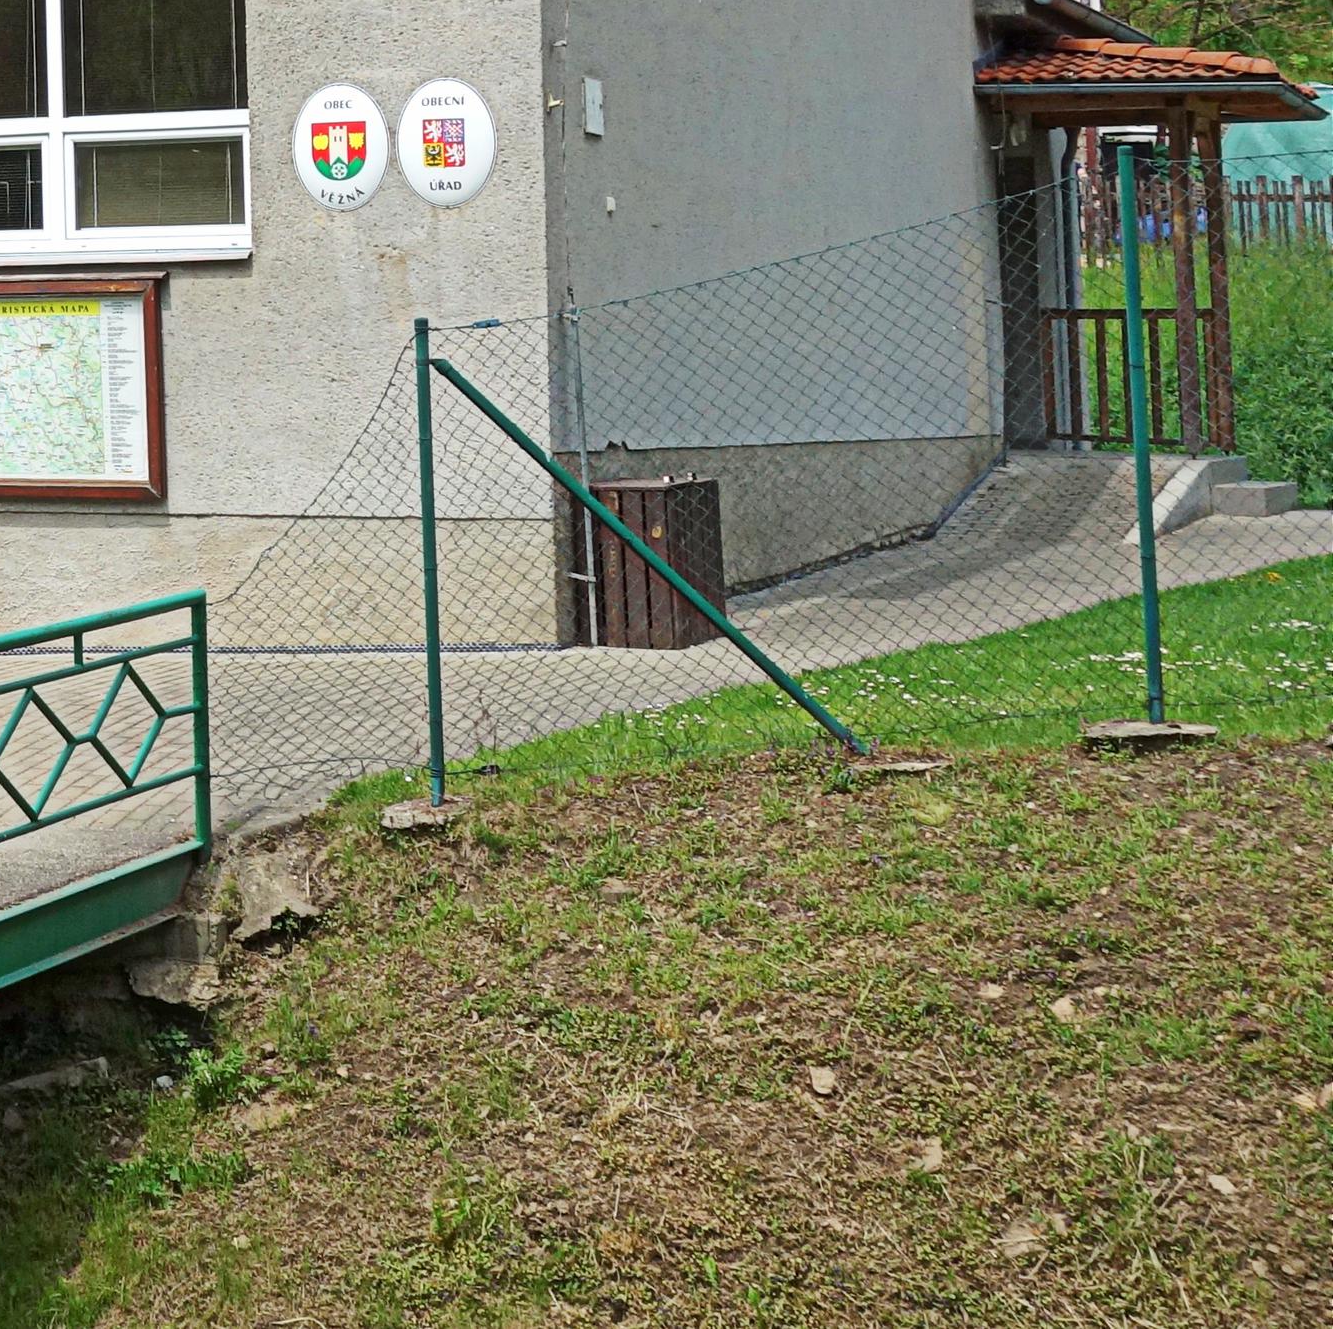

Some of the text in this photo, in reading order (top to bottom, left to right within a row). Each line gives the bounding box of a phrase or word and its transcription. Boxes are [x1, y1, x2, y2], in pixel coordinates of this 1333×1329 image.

[324, 100, 353, 109] OBEC
[421, 94, 465, 106] OBECNÍ
[429, 178, 462, 191] ÚŘAD
[61, 305, 89, 313] MAPA
